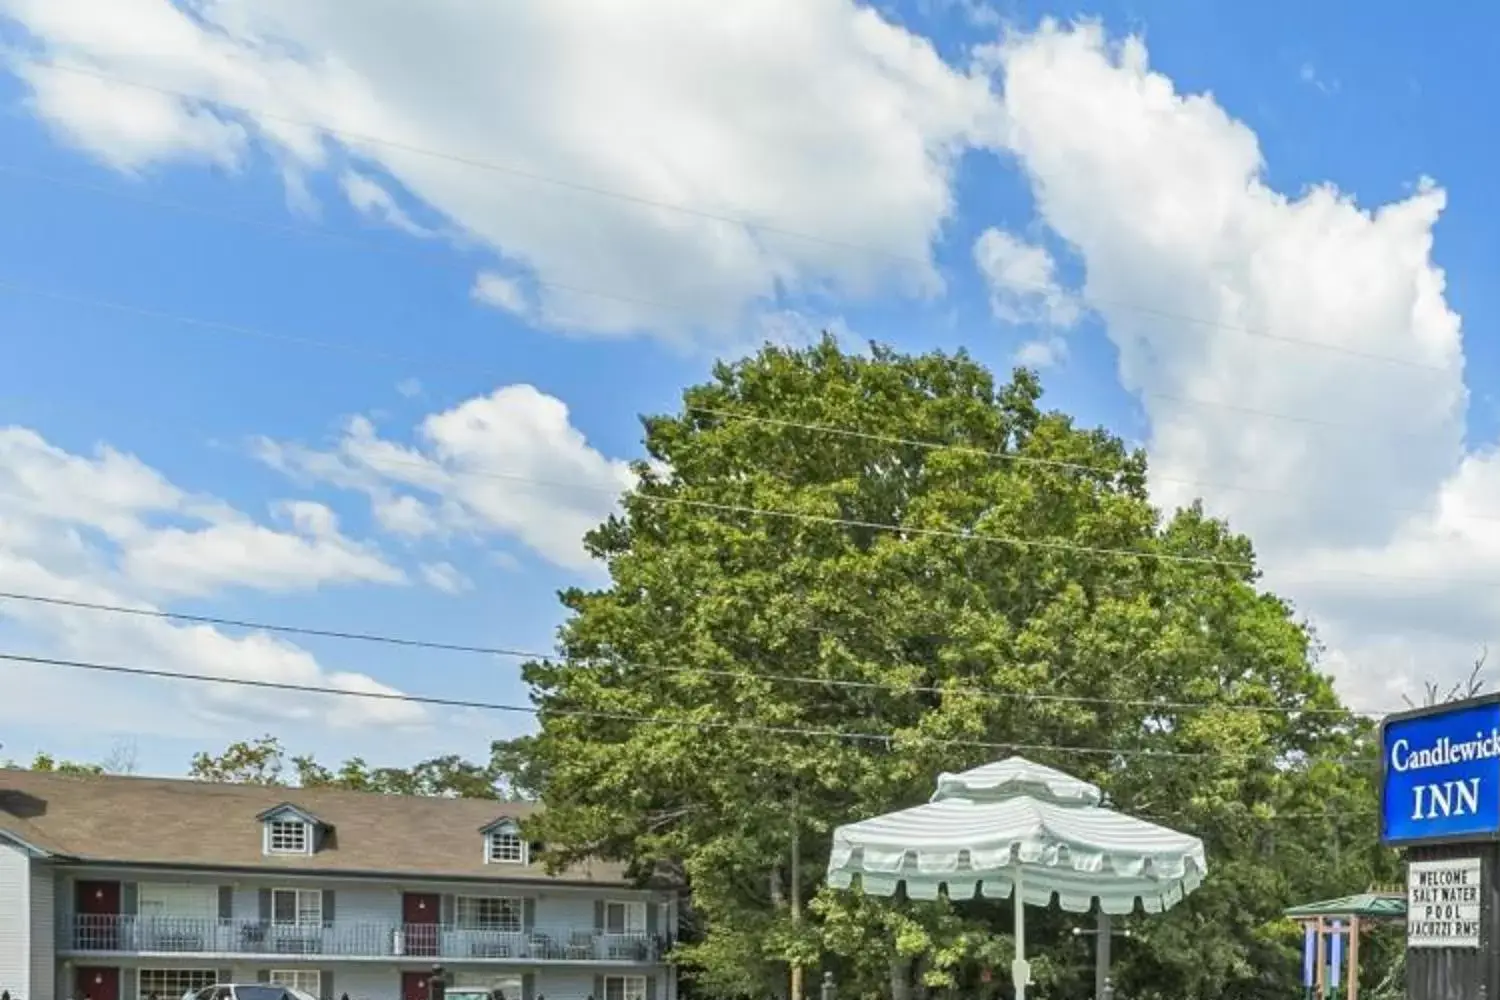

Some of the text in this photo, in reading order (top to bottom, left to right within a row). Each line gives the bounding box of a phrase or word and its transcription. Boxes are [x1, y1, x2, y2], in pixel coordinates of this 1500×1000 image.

[1411, 777, 1481, 820] INN
[1420, 869, 1467, 886] WELCOME
[1413, 887, 1477, 903] SALT WATER
[1425, 904, 1461, 919] POOL
[1408, 921, 1479, 937] JACUZZI RMS
